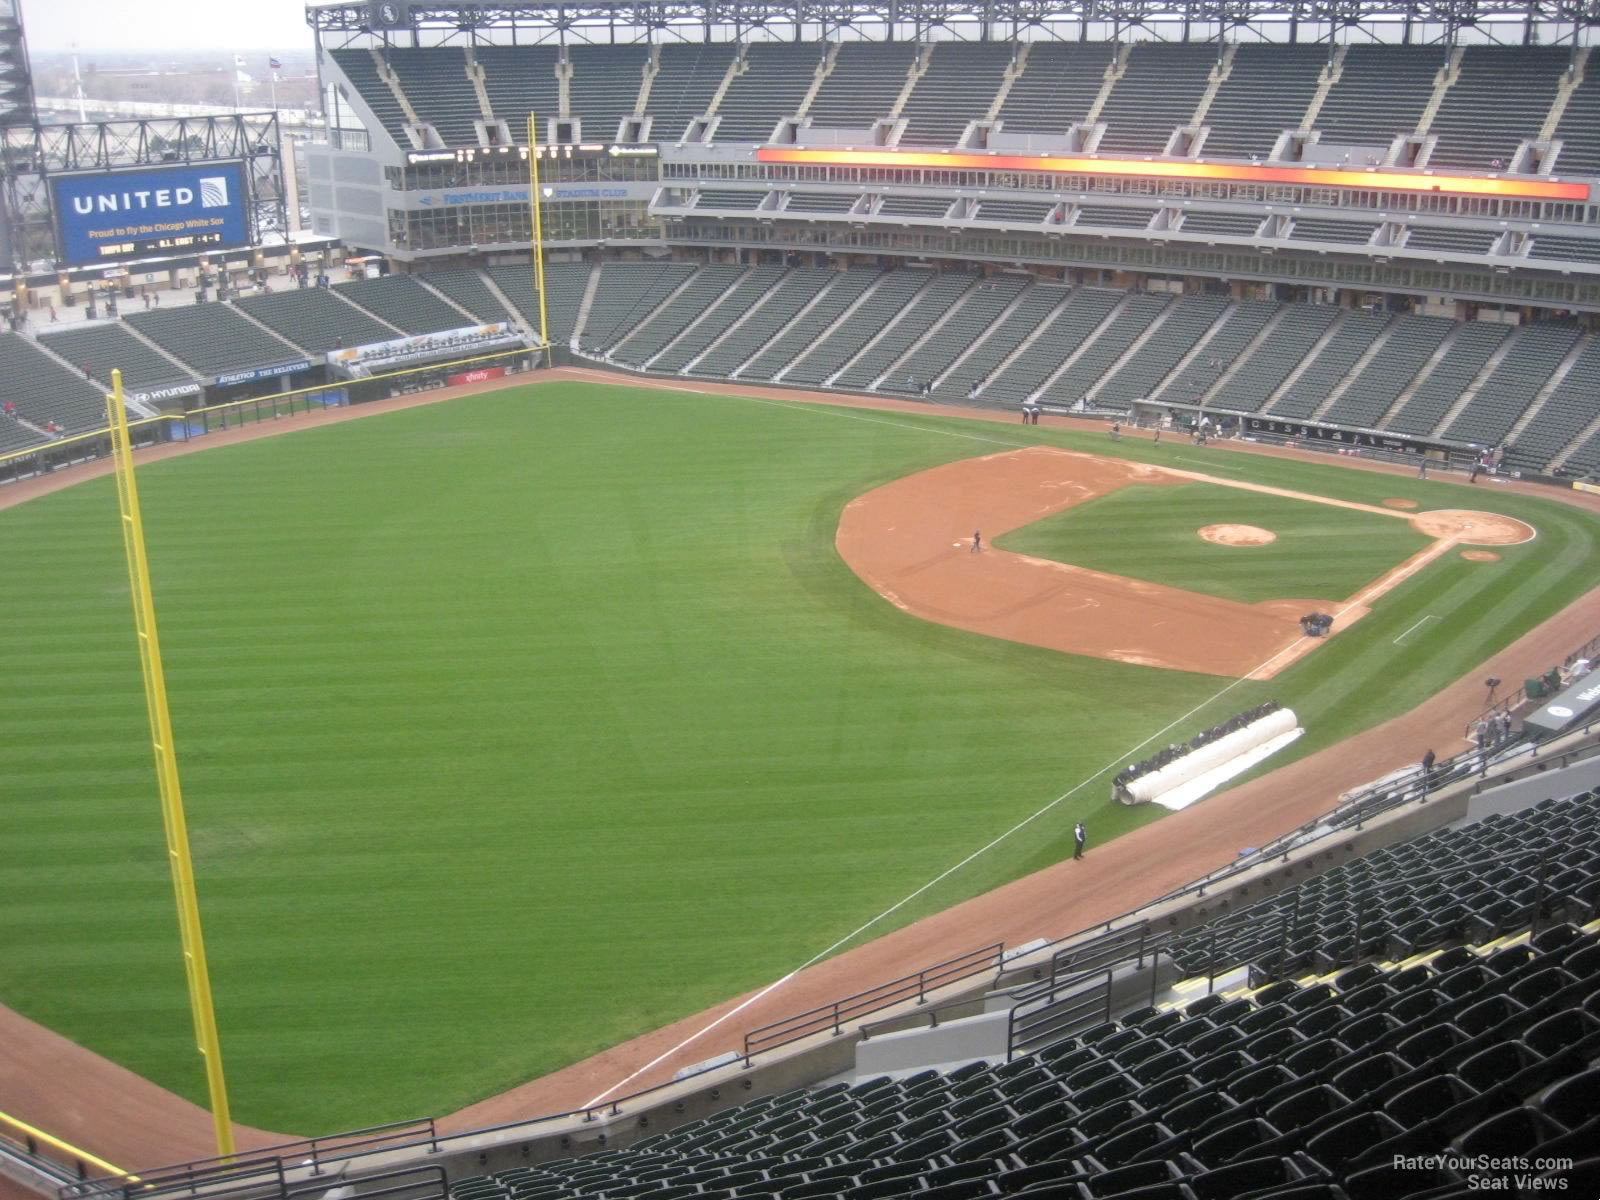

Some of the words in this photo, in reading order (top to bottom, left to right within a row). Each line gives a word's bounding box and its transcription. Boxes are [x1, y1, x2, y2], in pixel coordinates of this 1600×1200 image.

[73, 187, 194, 215] UNITED
[88, 228, 115, 239] Proud
[116, 228, 126, 237] to
[127, 226, 138, 236] fly
[140, 224, 153, 234] the
[154, 221, 185, 233] Chicago
[186, 219, 209, 230] White
[210, 217, 225, 226] Sox
[219, 371, 255, 384] ATHLETICO
[258, 367, 272, 377] THE
[273, 362, 308, 375] RELIEVERS
[465, 371, 488, 383] xfinity
[151, 383, 200, 399] HYUNDAI
